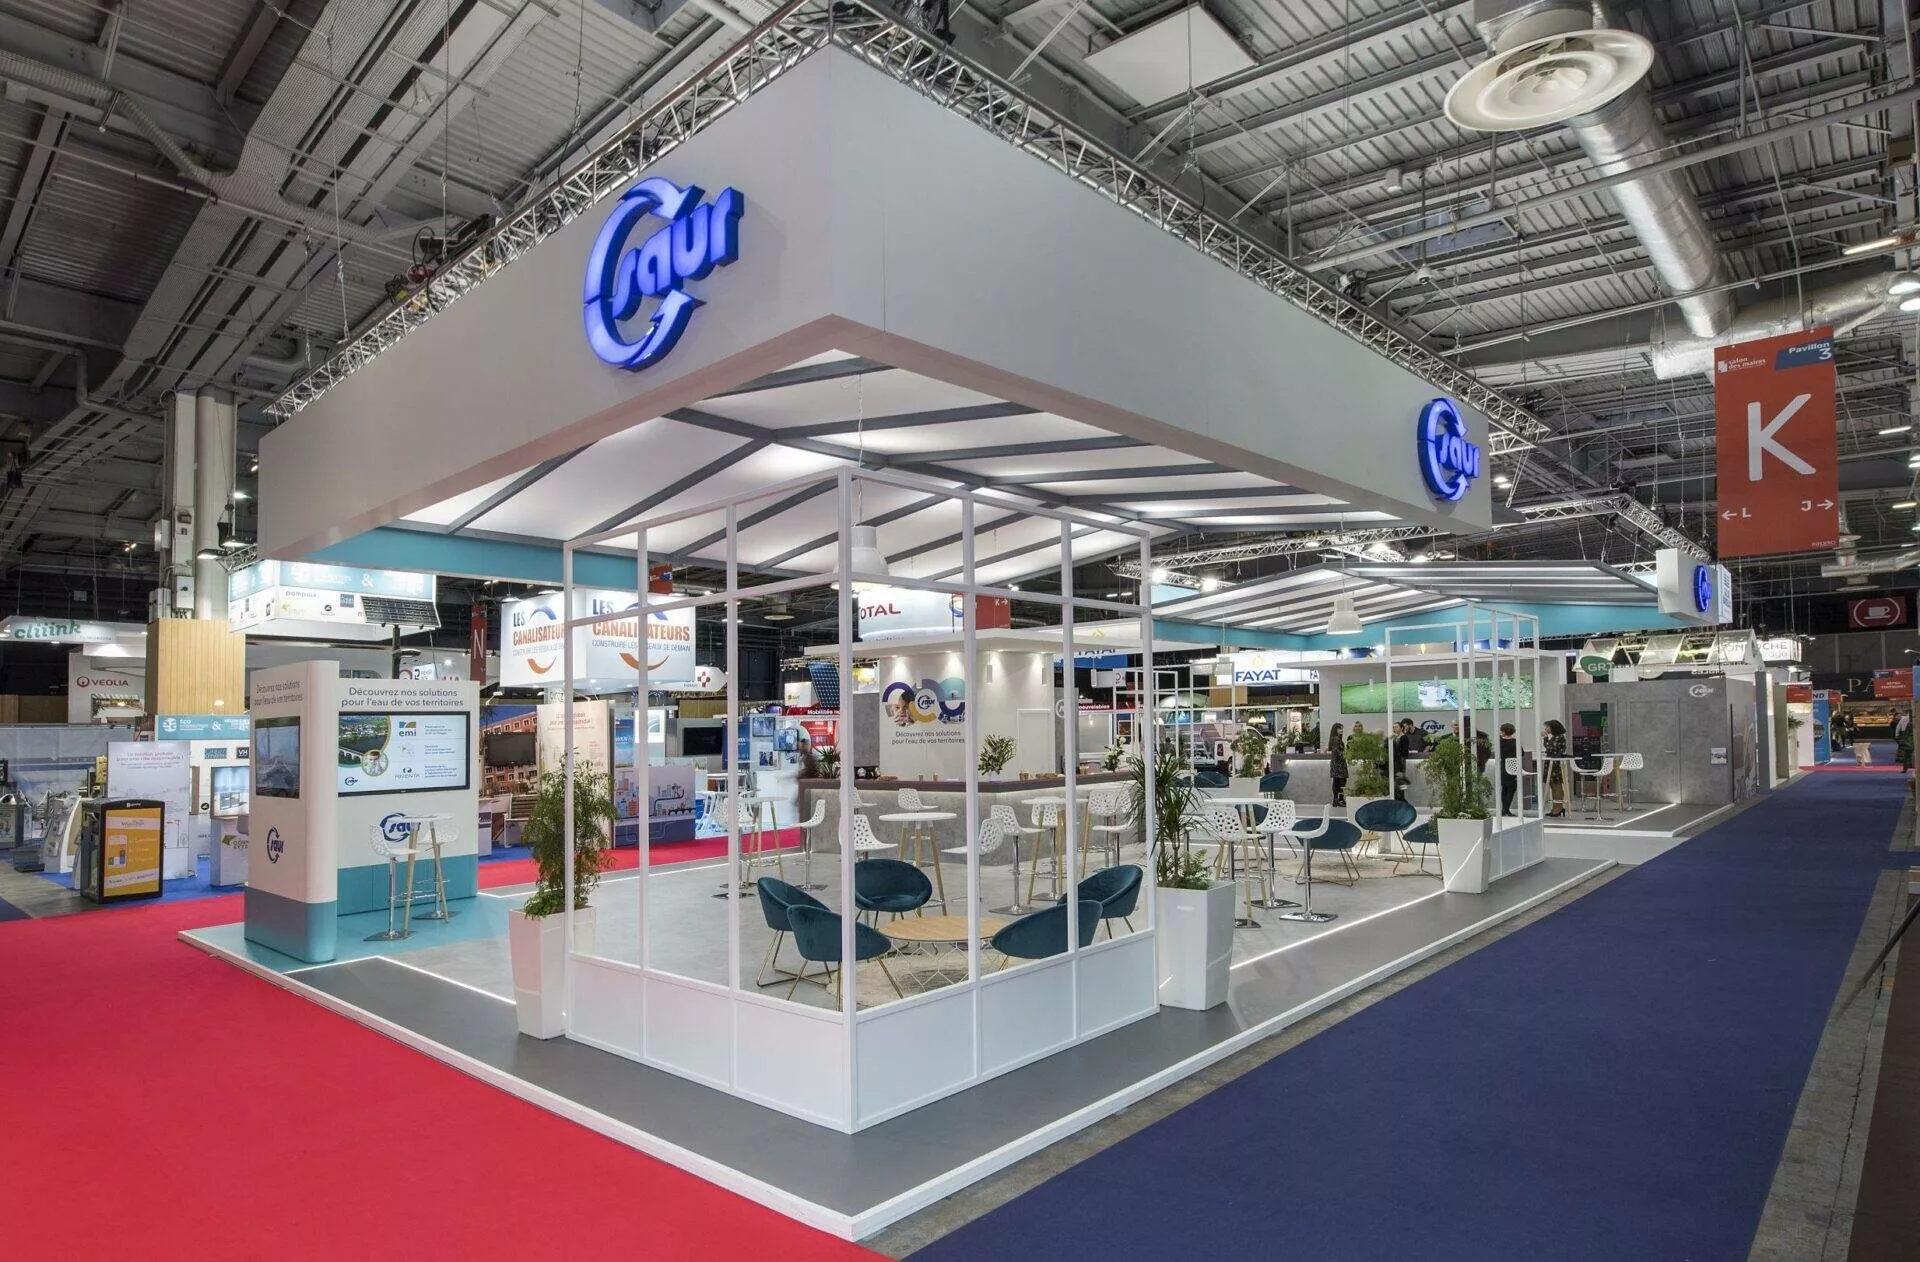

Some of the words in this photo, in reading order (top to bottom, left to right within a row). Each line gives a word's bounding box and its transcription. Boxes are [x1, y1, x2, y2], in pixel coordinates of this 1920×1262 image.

[1788, 341, 1830, 354] Pavillon
[1819, 347, 1832, 360] 3
[1747, 393, 1817, 482] K
[1801, 500, 1812, 511] J
[1741, 507, 1752, 519] L
[513, 611, 525, 627] LES
[592, 621, 691, 642] CANALIATEURS
[473, 628, 485, 660] N
[1235, 670, 1280, 682] FAYAT
[349, 687, 399, 697] Découvrez
[419, 688, 458, 697] solutions
[341, 699, 364, 708] pour
[367, 698, 389, 706] l'eau
[398, 729, 417, 737] emi
